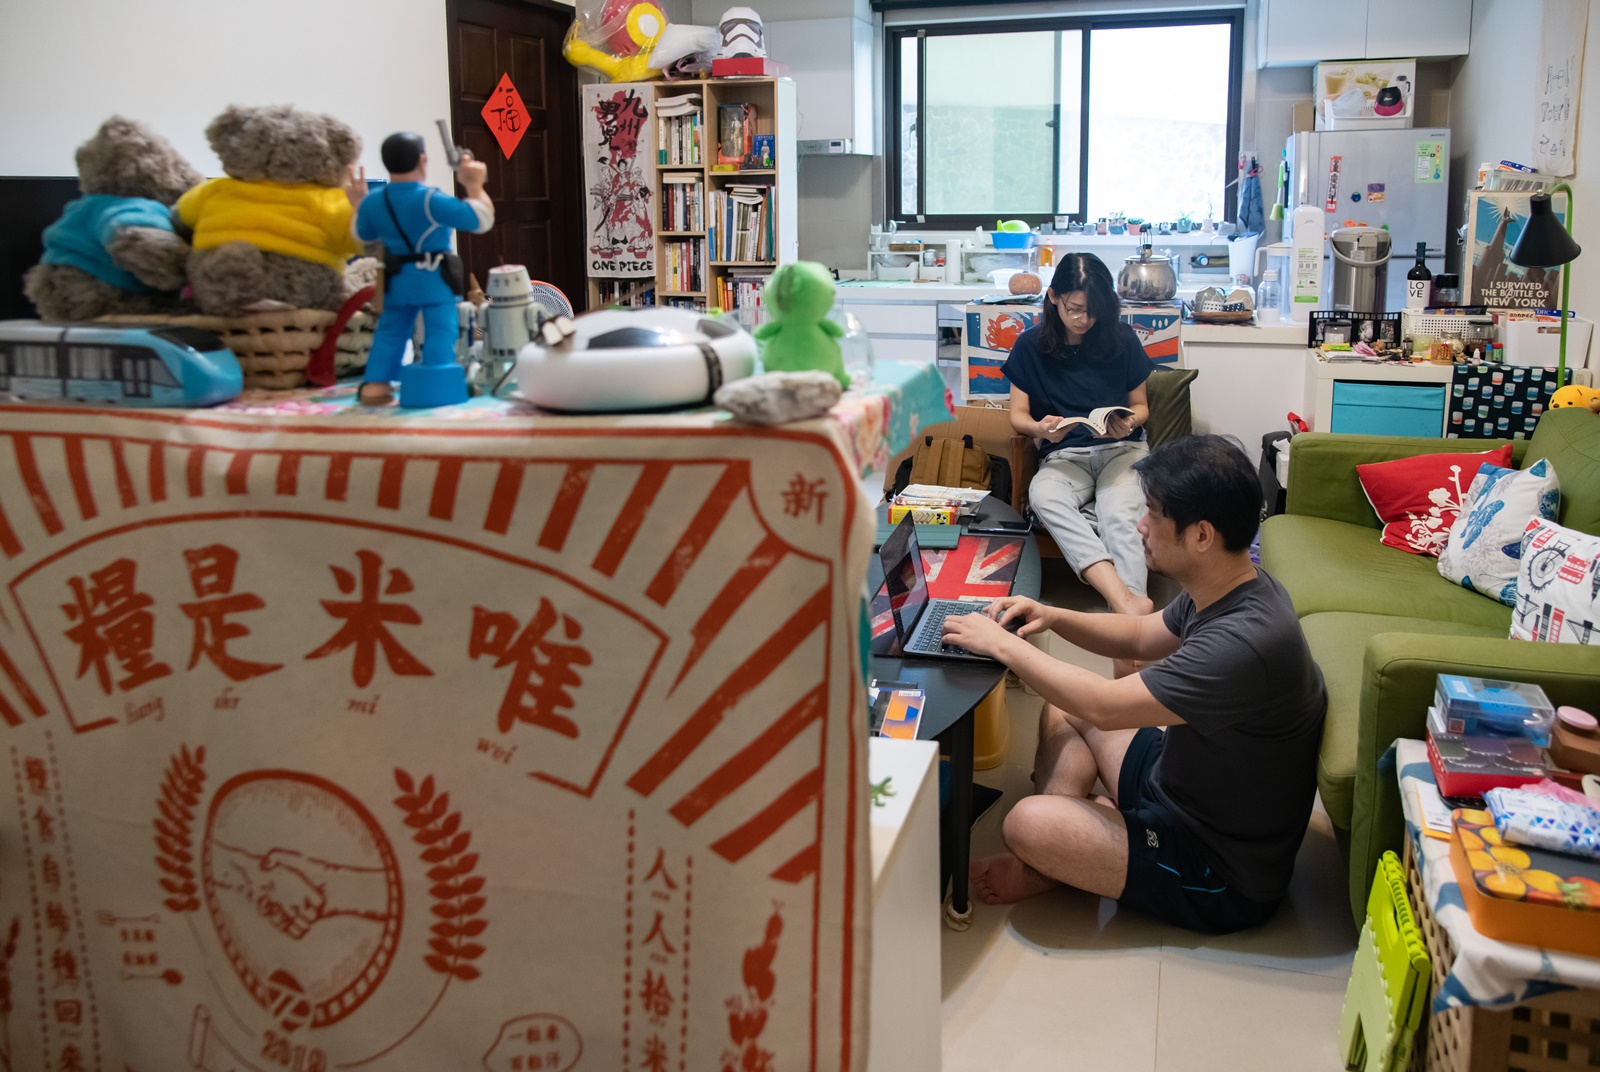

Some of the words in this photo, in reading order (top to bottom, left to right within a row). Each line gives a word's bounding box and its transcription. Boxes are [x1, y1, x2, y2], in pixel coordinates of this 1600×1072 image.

[592, 260, 616, 271] ONE
[618, 260, 654, 271] PIECE
[1409, 281, 1425, 290] LO
[1496, 281, 1542, 290] SURVIVED
[1409, 289, 1423, 298] VE
[1481, 288, 1497, 296] THE
[1500, 289, 1533, 298] BATTLE
[1536, 290, 1549, 298] OF
[1484, 297, 1510, 306] NEW
[1514, 298, 1546, 307] YORK
[780, 472, 829, 525] 新
[476, 736, 518, 764] wei
